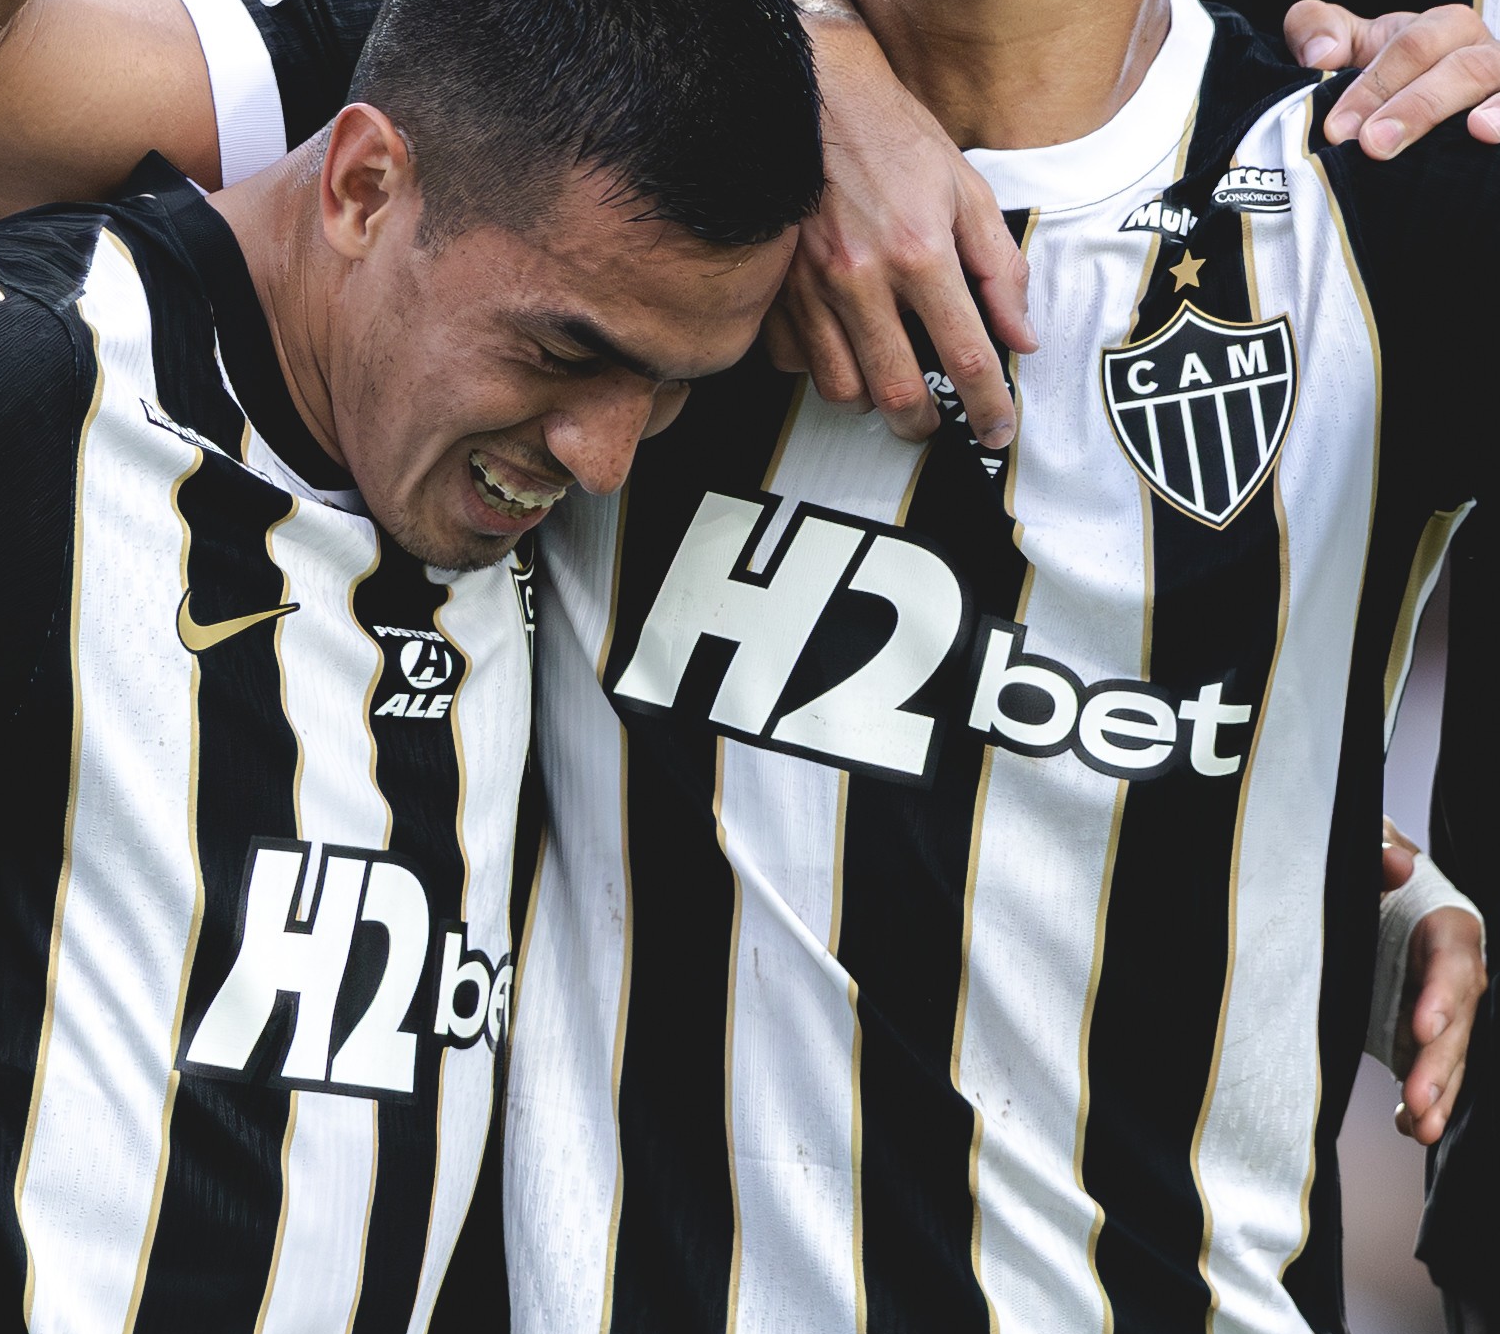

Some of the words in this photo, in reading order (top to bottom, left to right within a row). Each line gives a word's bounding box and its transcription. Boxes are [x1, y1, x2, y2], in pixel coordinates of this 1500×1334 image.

[1126, 339, 1269, 395] CAM
[372, 625, 446, 643] POSTOS
[612, 491, 1253, 777] H2bet
[373, 693, 454, 719] ALE
[185, 848, 514, 1093] H2be
